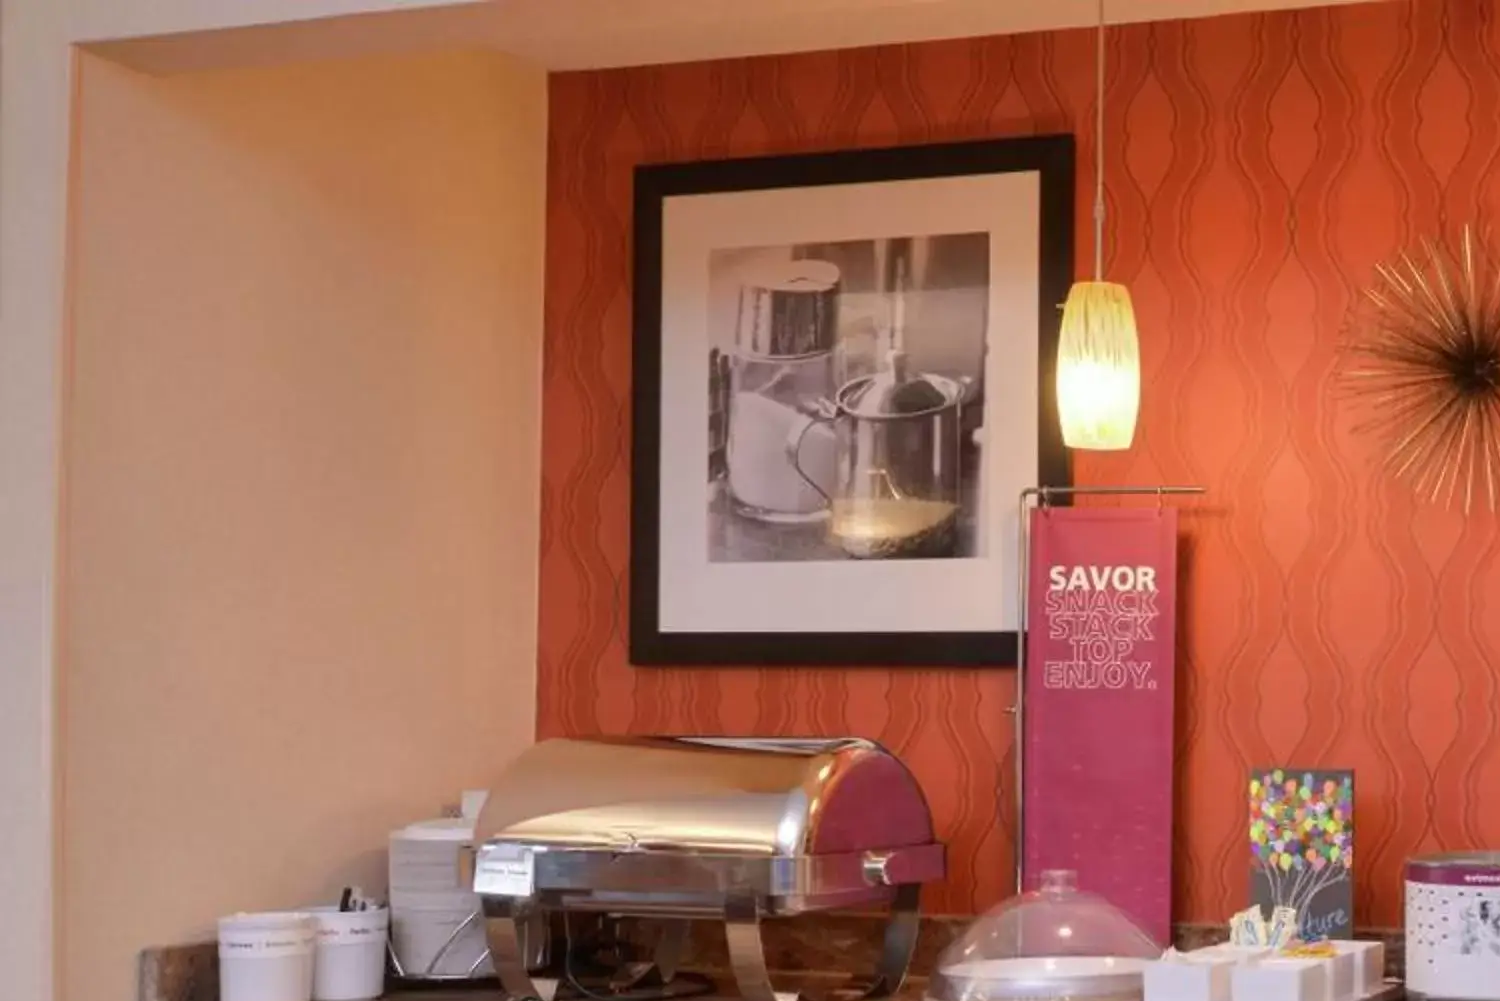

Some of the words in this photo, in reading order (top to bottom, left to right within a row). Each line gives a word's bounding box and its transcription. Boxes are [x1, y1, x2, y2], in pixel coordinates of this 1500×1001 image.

[1049, 565, 1157, 591] SAVOR
[1045, 590, 1159, 614] SNACK
[1049, 614, 1154, 640] STACK
[1070, 639, 1133, 664] TOP
[1043, 662, 1157, 689] ENJOY.
